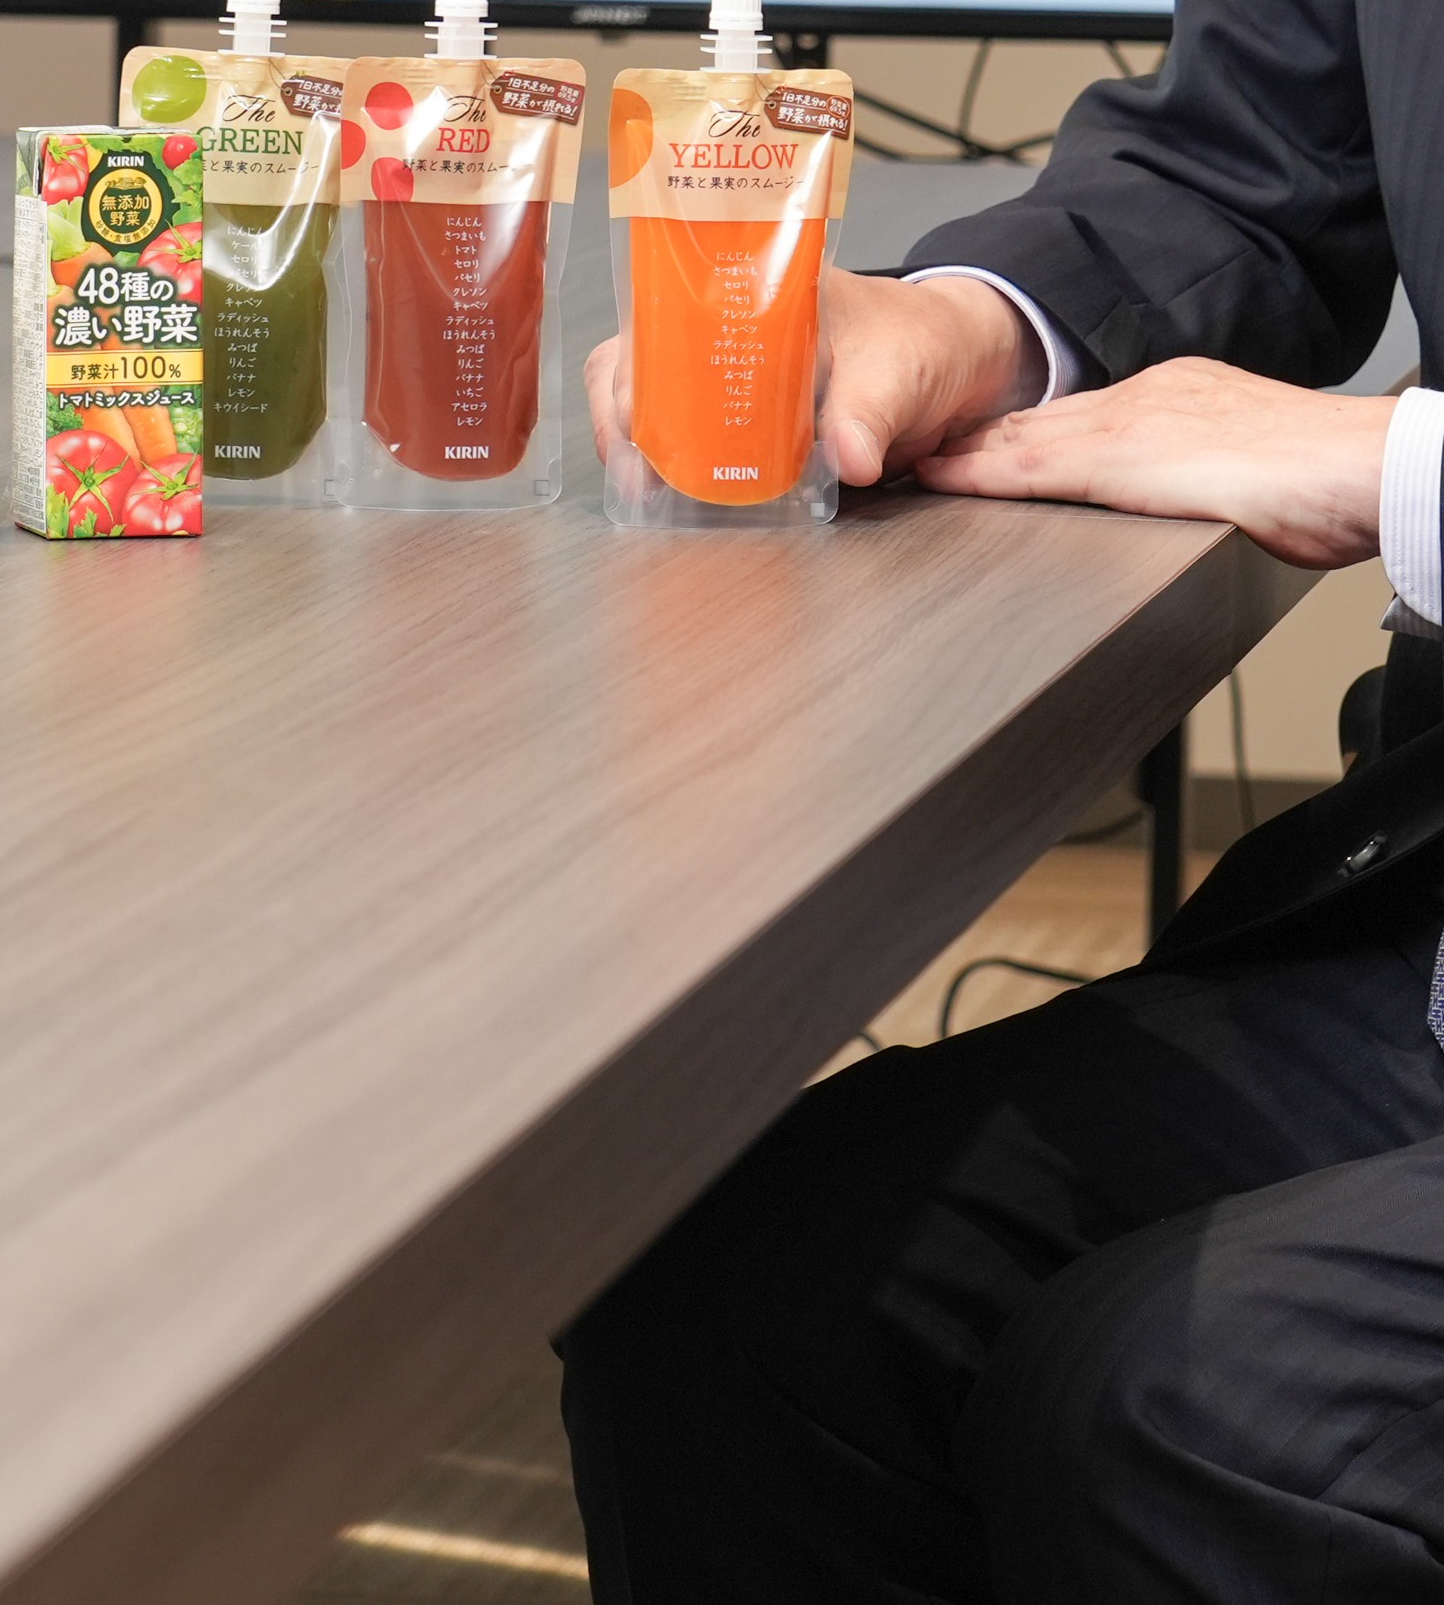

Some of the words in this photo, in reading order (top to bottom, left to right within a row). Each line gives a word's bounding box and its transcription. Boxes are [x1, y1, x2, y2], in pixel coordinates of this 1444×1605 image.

[508, 77, 556, 94] 1日不足分の
[502, 91, 578, 116] 野菜が摂れる!
[782, 92, 827, 108] 1日不足分の
[222, 94, 276, 123] The
[708, 110, 761, 138] The
[778, 106, 848, 131] 野菜が摂れる!
[196, 126, 304, 155] GREEN
[436, 127, 491, 154] RED
[107, 155, 145, 168] KIRIN
[669, 143, 799, 170] YELLOW
[102, 194, 150, 211] 無添加
[110, 211, 140, 227] 野菜
[447, 217, 482, 227] にんじん
[445, 231, 487, 241] さつまいも
[455, 245, 477, 255] トマト
[717, 251, 754, 262] にんじん
[454, 259, 480, 269] セロリ
[713, 266, 758, 276] さつまいも
[78, 267, 174, 305] 48種の
[453, 287, 487, 296] クレソン
[723, 281, 749, 291] セロリ
[225, 297, 263, 308] キャベツ
[453, 301, 488, 311] キャベツ
[217, 312, 270, 324] ラディッシュ
[722, 309, 757, 319] クレソン
[55, 303, 198, 346] 濃い野菜
[446, 316, 494, 326] ラディッシュ
[214, 327, 270, 339] ほうれんそう
[443, 329, 496, 340] ほうれんそう
[721, 325, 758, 334] キャベツ
[713, 340, 765, 350] ラディッシュ
[229, 357, 257, 368] りんご
[458, 358, 484, 369] りんご
[710, 355, 765, 365] ほうれんそう
[71, 355, 181, 380] 野菜汁100%
[226, 373, 257, 384] バナナ
[455, 373, 484, 383] バナナ
[228, 388, 256, 398] レモン
[456, 387, 484, 398] いちご
[726, 385, 753, 396] りんご
[59, 389, 195, 409] トマトミックスジュース
[213, 402, 269, 414] キウイシード
[451, 402, 488, 412] アセロラ
[723, 401, 752, 411] バナナ
[457, 416, 483, 427] レモン
[725, 416, 752, 426] レモン
[214, 445, 261, 459] KIRIN
[444, 446, 489, 459] KIRIN
[713, 467, 759, 480] KIRIN
